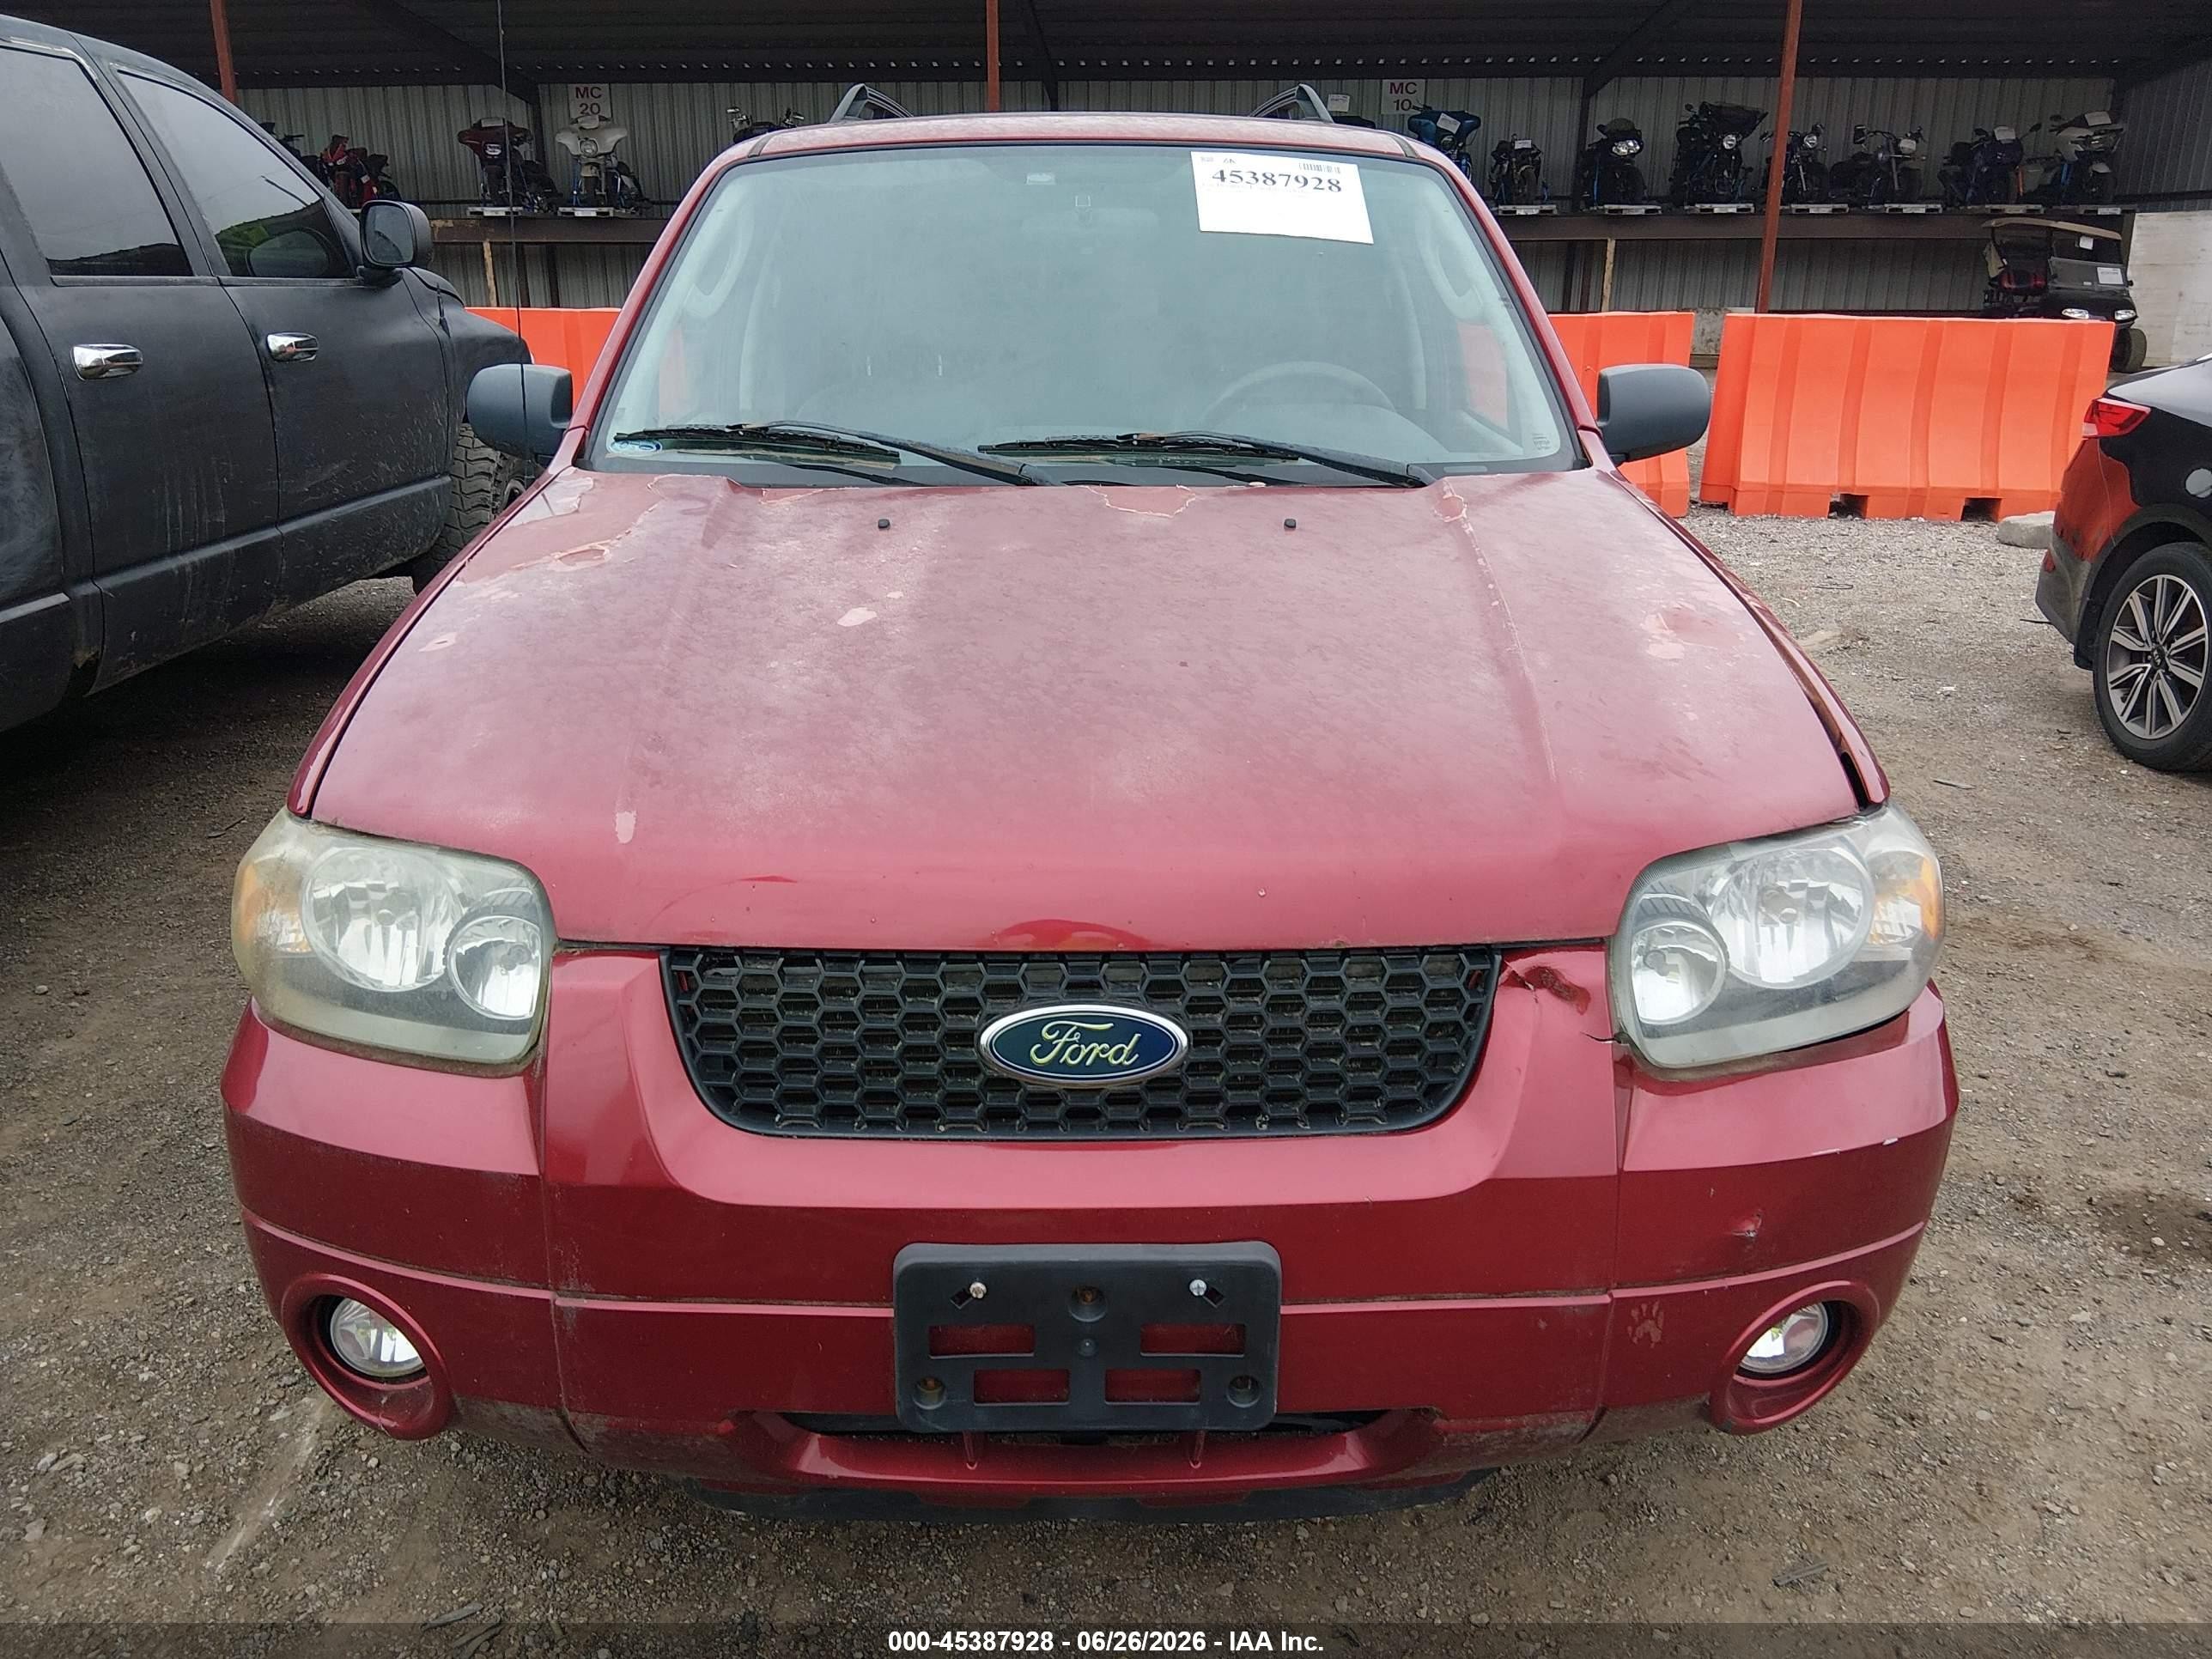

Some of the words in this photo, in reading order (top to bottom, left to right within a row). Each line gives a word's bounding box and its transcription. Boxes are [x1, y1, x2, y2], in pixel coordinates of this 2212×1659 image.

[575, 87, 602, 99] MC
[1389, 82, 1417, 94] MC
[580, 103, 601, 115] 20
[1393, 99, 1412, 111] 10
[1212, 169, 1342, 193] 45387928
[1030, 1020, 1141, 1066] Ford
